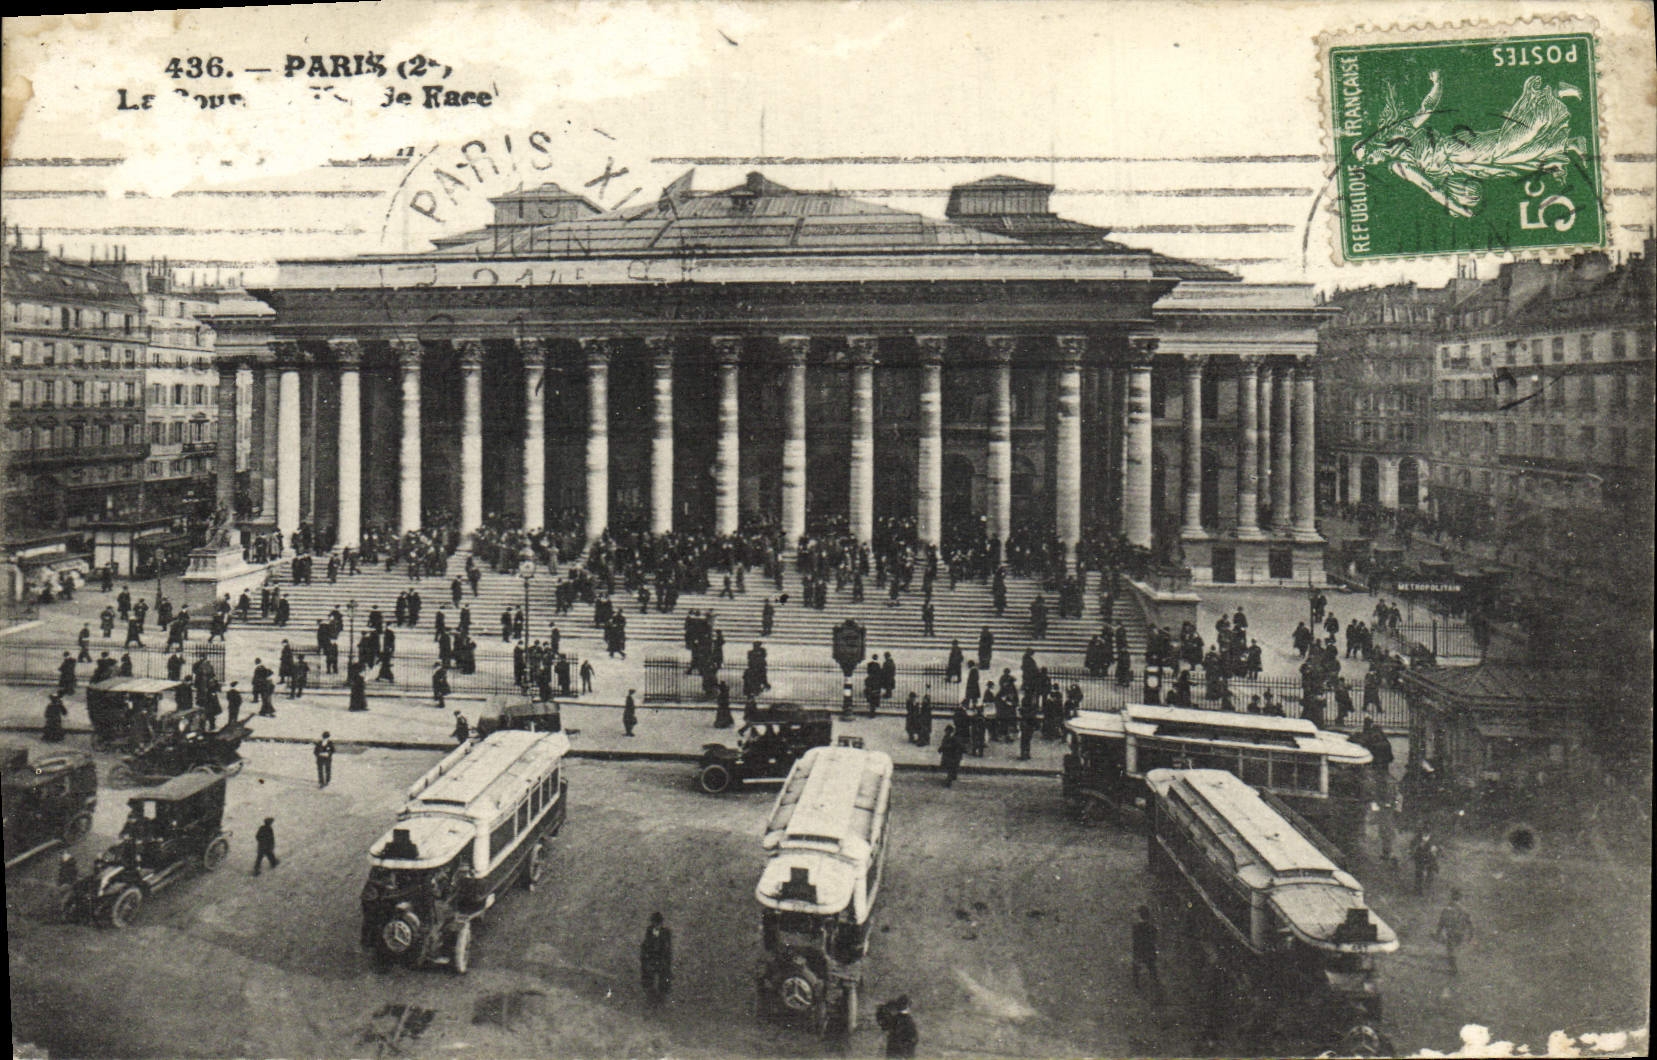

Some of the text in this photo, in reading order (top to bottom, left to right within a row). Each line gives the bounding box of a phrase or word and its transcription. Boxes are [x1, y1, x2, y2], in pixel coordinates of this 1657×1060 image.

[1493, 44, 1577, 67] POSTES
[409, 130, 552, 224] PARIS
[1397, 583, 1461, 592] METROPOLITAIN
